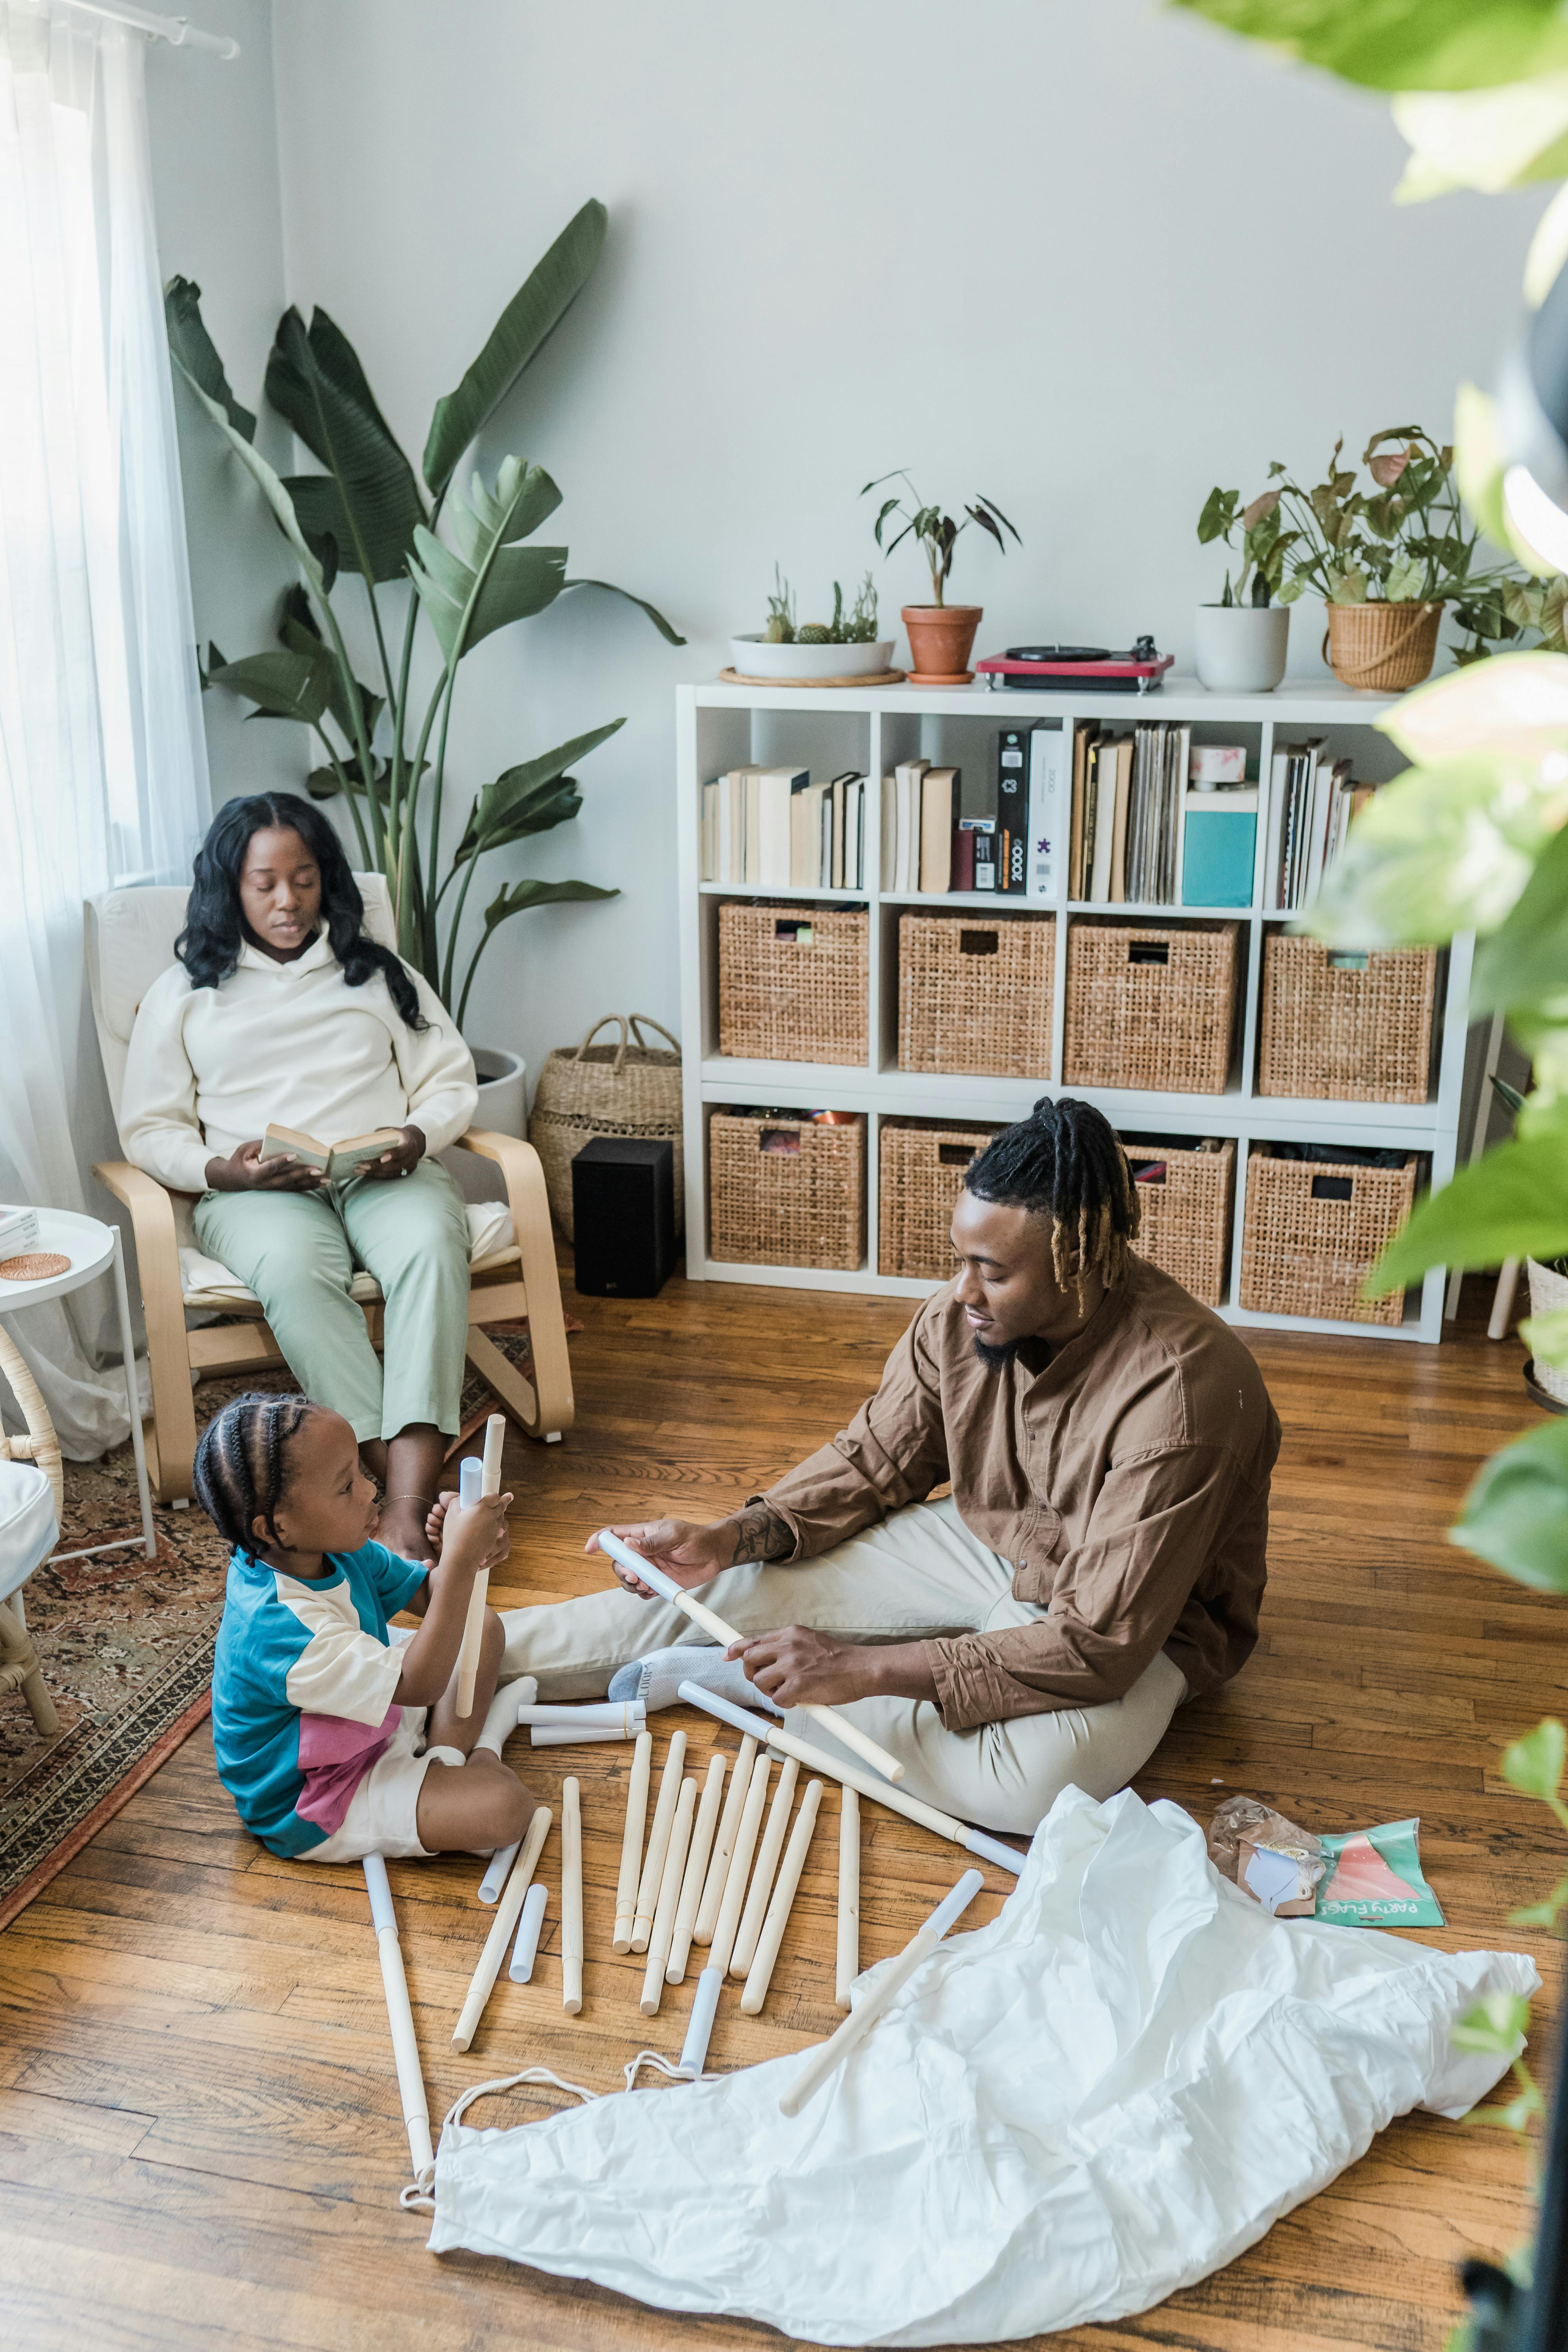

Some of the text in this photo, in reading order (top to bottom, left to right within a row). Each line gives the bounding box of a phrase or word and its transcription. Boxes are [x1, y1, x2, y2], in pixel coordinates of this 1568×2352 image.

[1012, 846, 1023, 881] 2000
[638, 1662, 653, 1696] LOOM
[1321, 1903, 1368, 1916] FLAGS
